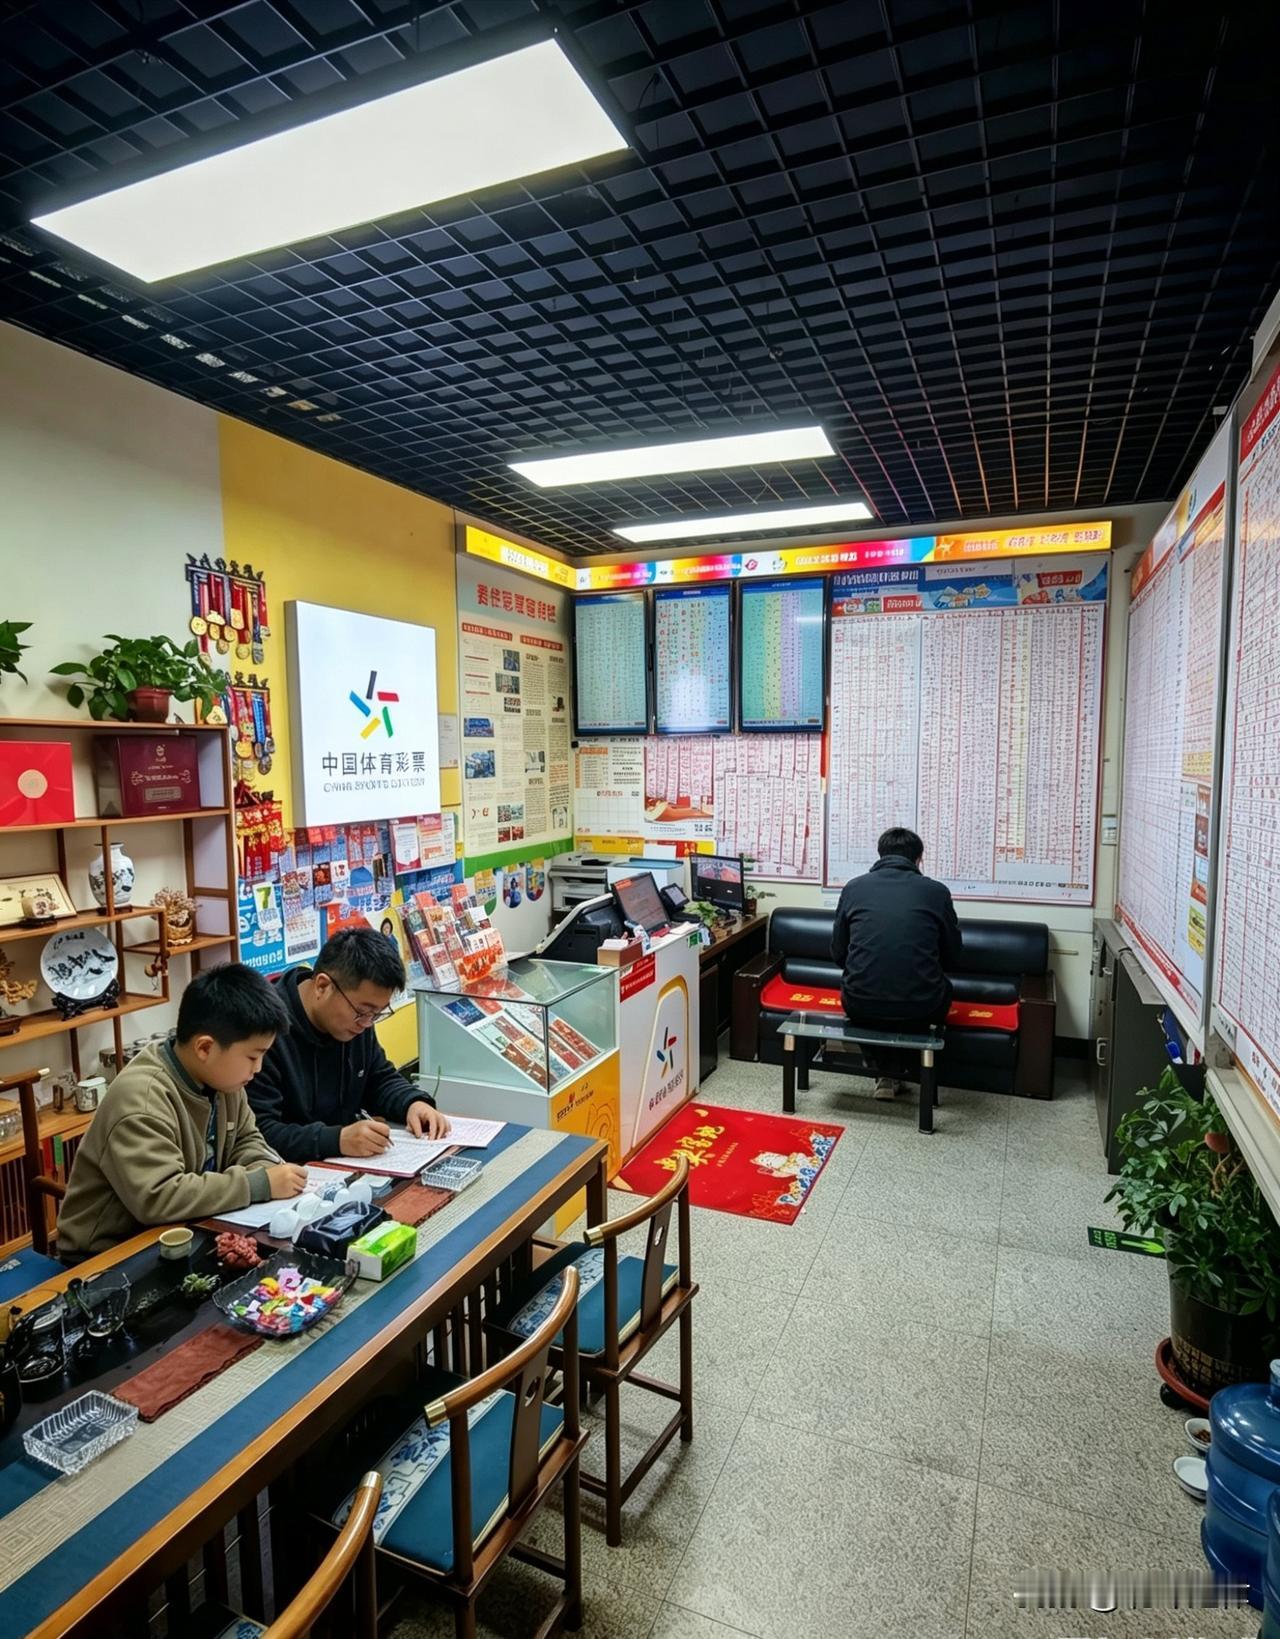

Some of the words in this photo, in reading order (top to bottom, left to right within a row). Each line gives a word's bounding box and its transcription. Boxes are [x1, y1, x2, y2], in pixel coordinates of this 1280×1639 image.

[321, 751, 426, 777] 中国体育彩票
